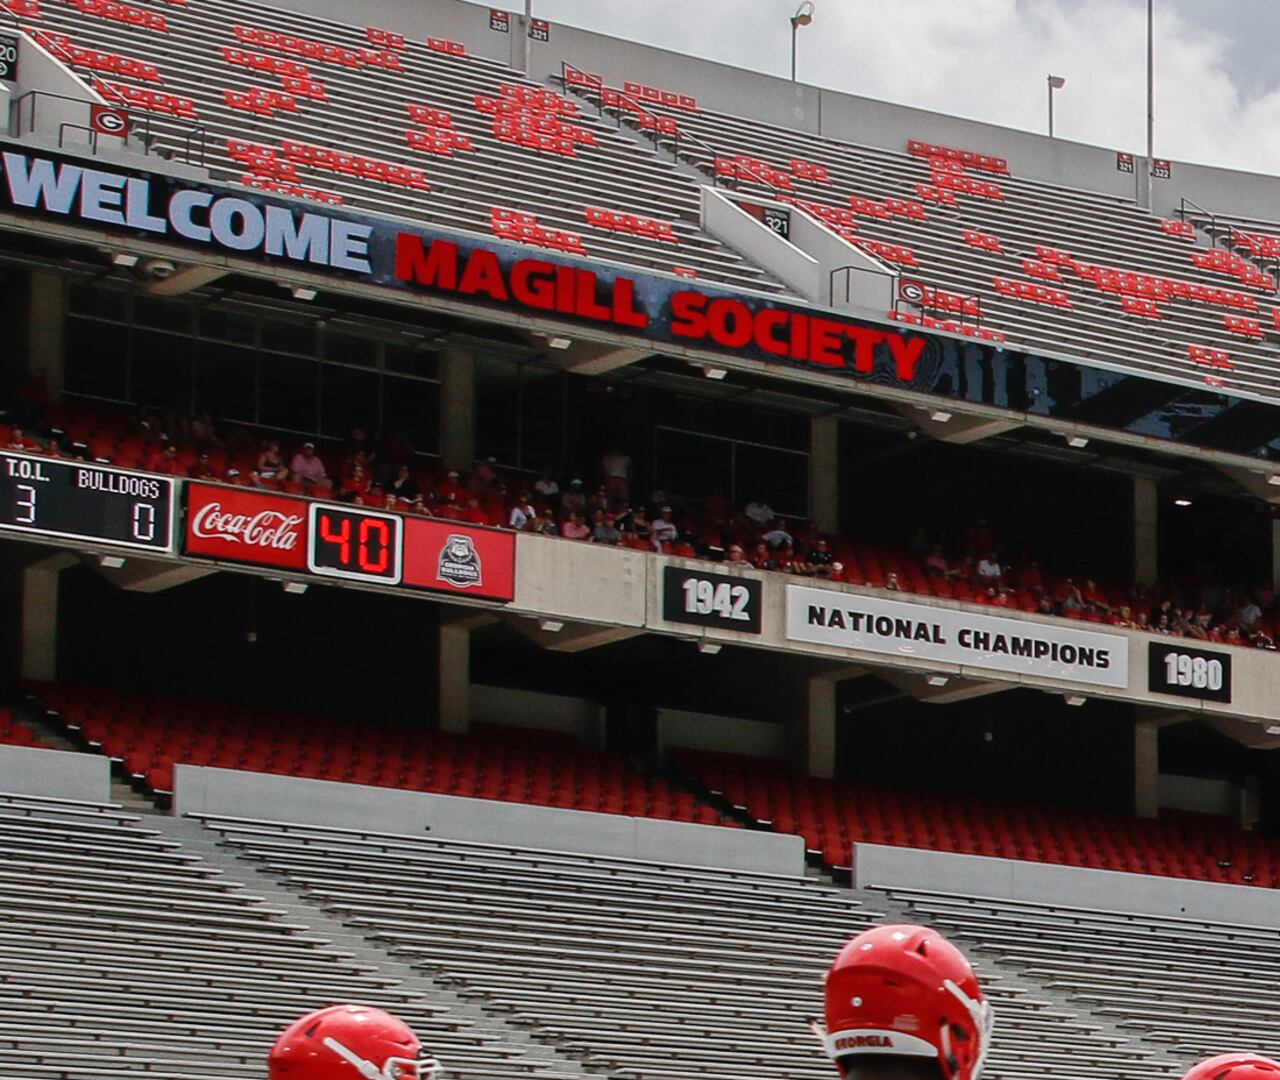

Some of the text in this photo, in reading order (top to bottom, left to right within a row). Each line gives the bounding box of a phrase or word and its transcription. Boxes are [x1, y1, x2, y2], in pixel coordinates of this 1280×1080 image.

[766, 216, 788, 234] 321
[2, 152, 927, 381] WELCOME MAGILL SOCIETY
[6, 458, 50, 482] T.O.L.
[78, 470, 160, 499] BULLDOGS
[16, 484, 36, 524] 3
[133, 502, 155, 541] 0
[192, 502, 304, 551] Coca-Cola
[319, 514, 389, 573] 40
[682, 578, 751, 622] 1942
[807, 604, 1111, 669] NATIONAL CHAMPIONS
[1164, 652, 1223, 691] 1980
